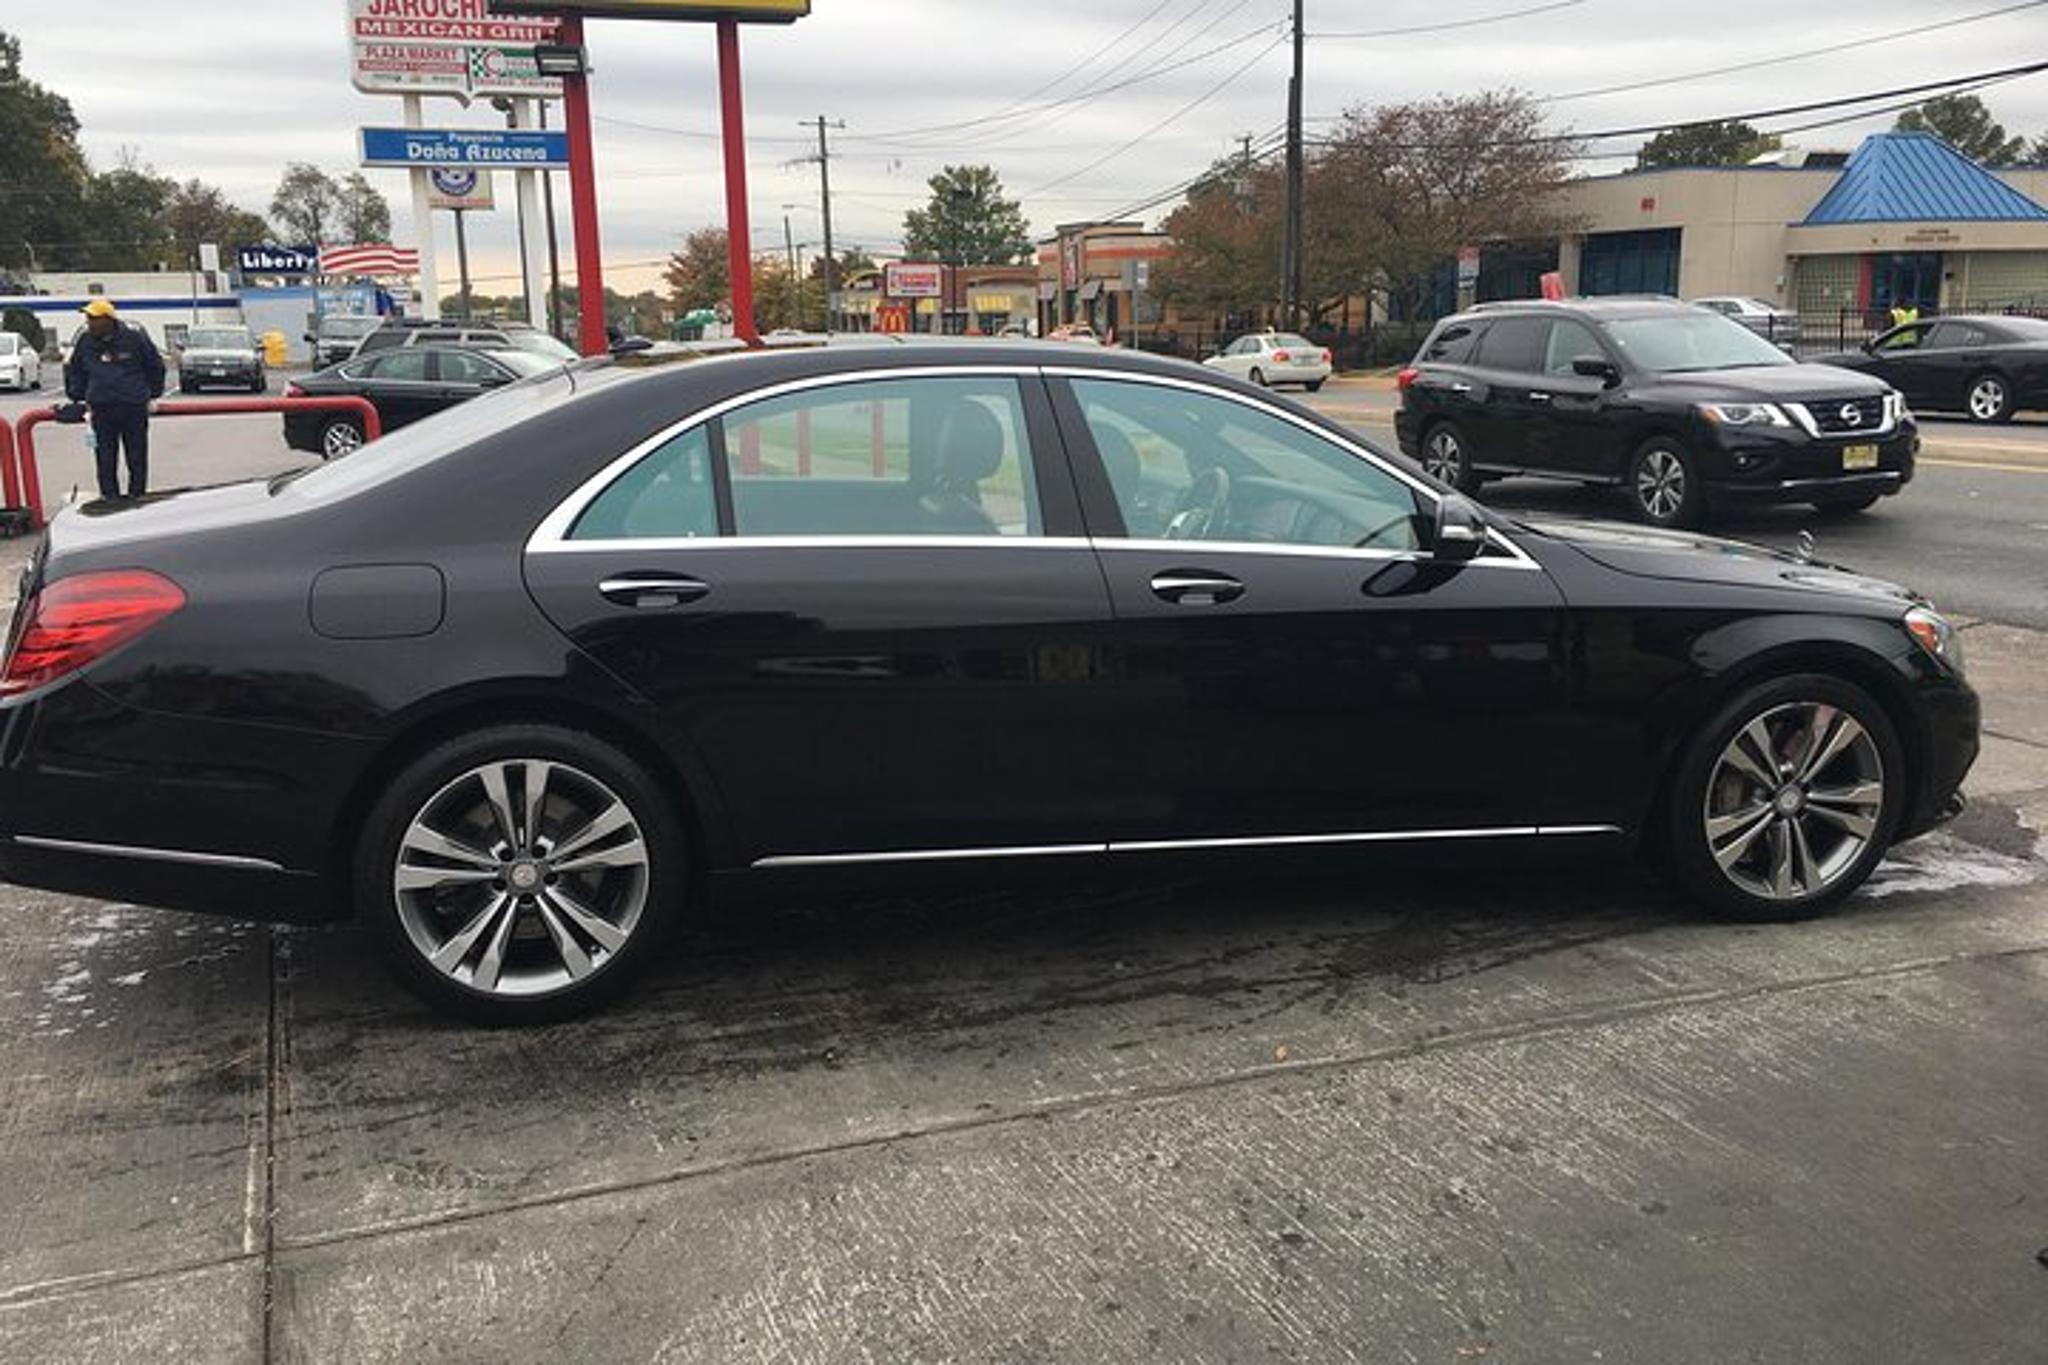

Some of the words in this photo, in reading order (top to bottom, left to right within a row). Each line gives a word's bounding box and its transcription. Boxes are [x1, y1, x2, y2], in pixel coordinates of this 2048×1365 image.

[360, 20, 482, 38] MEXICAN
[406, 142, 460, 159] Doña
[466, 144, 547, 161] Azucena
[242, 251, 314, 271] Liberty
